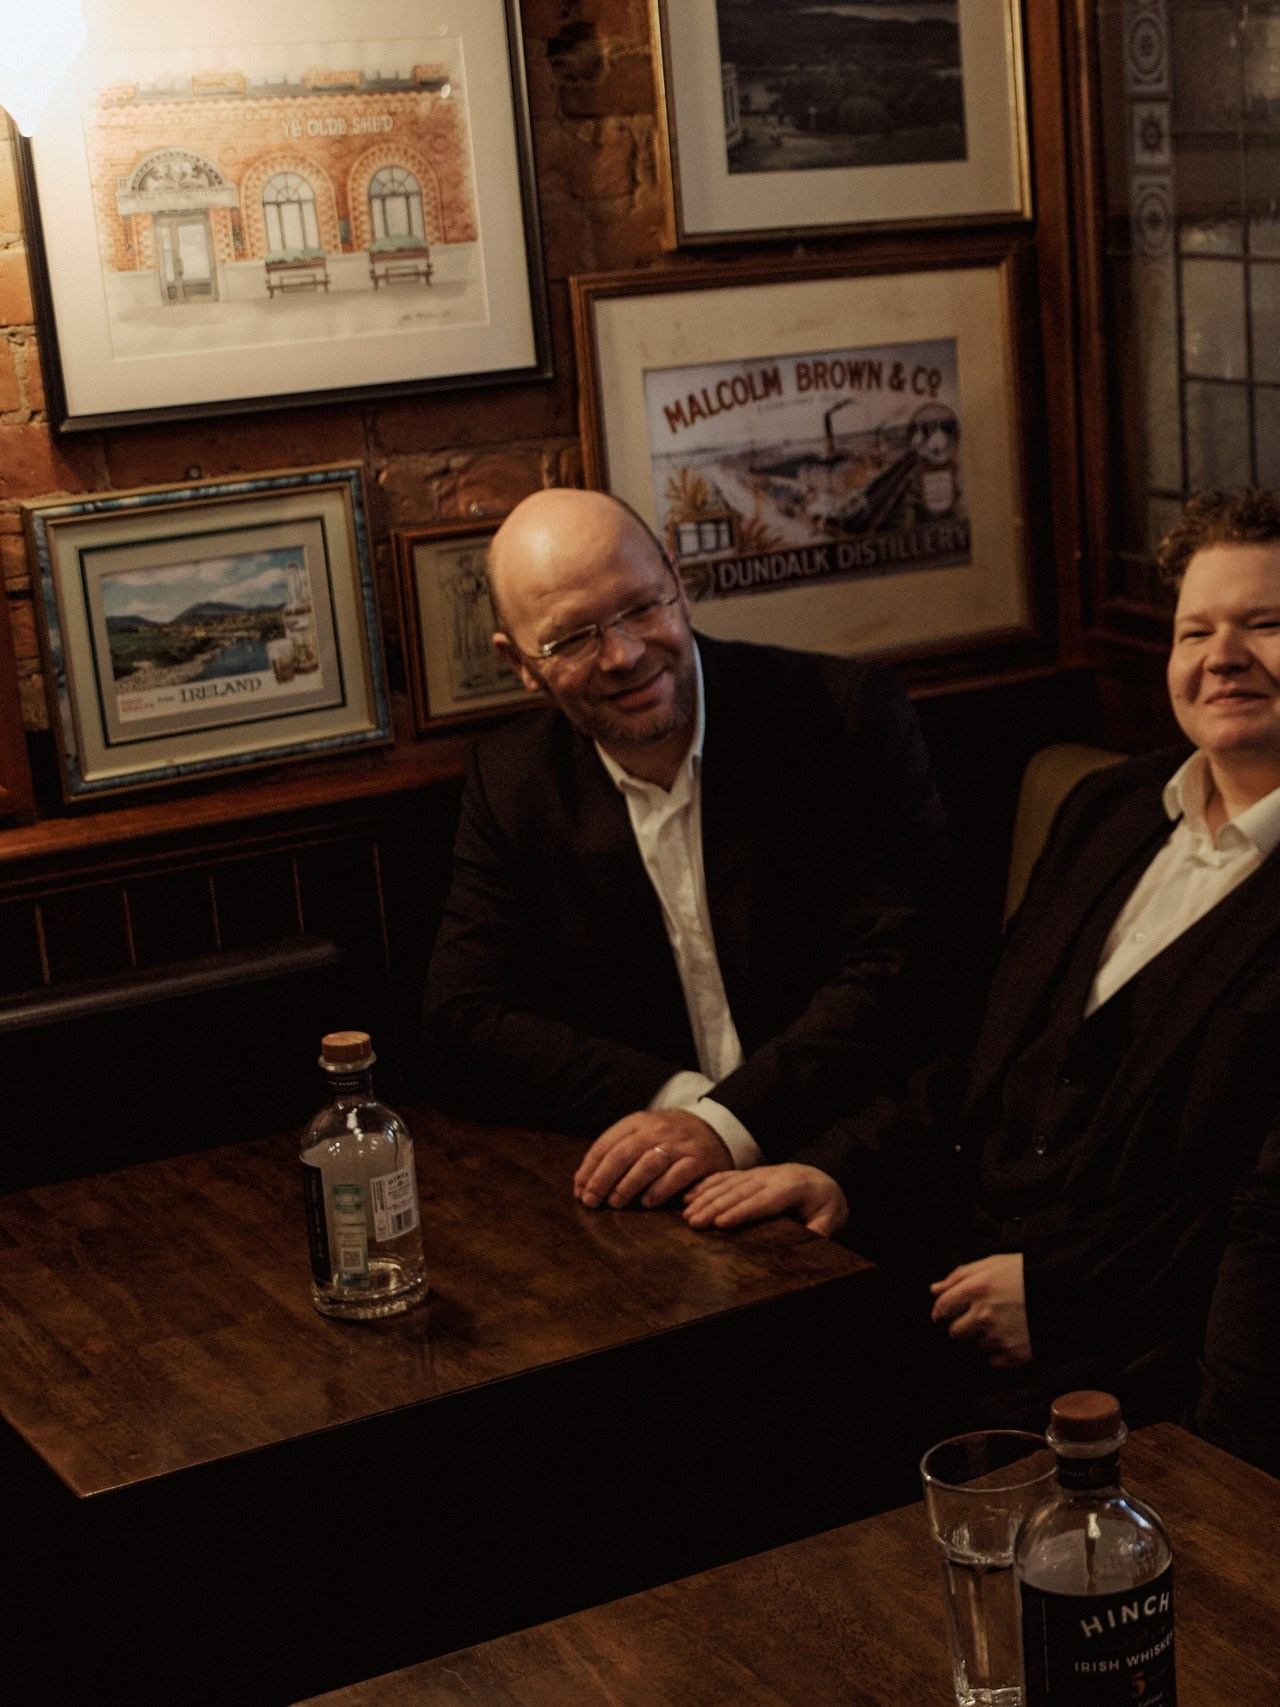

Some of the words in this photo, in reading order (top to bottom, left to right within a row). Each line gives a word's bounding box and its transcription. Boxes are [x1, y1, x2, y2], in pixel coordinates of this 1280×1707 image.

[282, 119, 302, 138] YE
[307, 117, 347, 137] OLDE
[352, 114, 394, 135] SHED
[662, 365, 783, 434] MALCOLM
[795, 359, 883, 392] BROWN
[718, 549, 831, 590] DUNDALK
[836, 525, 969, 569] DISTILLERY
[180, 678, 262, 701] IRELAND
[1080, 1591, 1170, 1639] HINCH
[1074, 1659, 1120, 1673] IRISH
[1129, 1670, 1146, 1698] 5
